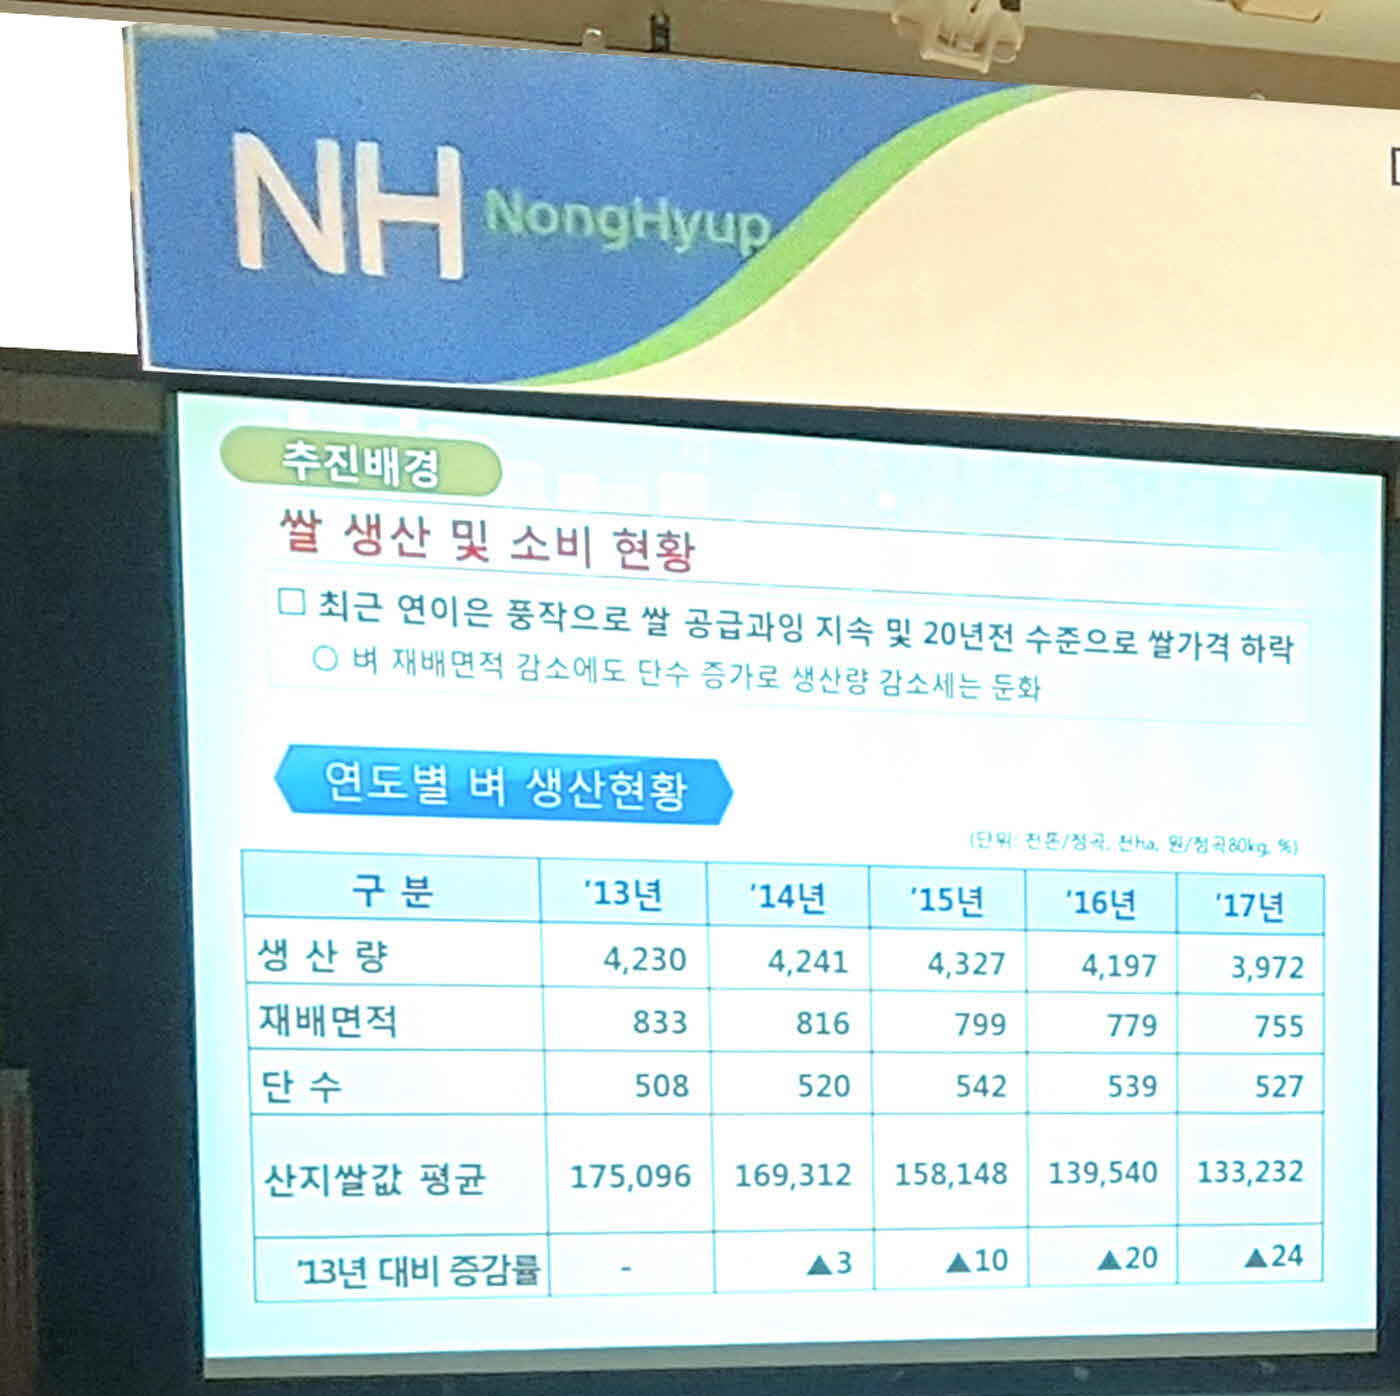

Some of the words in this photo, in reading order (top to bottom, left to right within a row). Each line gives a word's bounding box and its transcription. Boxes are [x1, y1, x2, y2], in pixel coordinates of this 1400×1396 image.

[231, 130, 464, 281] NH
[483, 187, 772, 256] NongHyup
[282, 441, 441, 488] 추진배경
[280, 509, 322, 553] 쌀
[345, 515, 430, 559] 생산
[452, 520, 489, 562] 및
[511, 526, 593, 569] 소비
[612, 529, 696, 573] 현황
[319, 590, 382, 624] 최근
[398, 594, 492, 629] 연이은
[507, 599, 631, 633] 풍작으로
[641, 606, 670, 637] 쌀
[685, 608, 803, 642] 공급과잉
[816, 616, 873, 648] 지속
[888, 619, 911, 648] 및
[924, 620, 1014, 653] 20년전
[1025, 625, 1138, 656] 수준으로
[1148, 630, 1230, 662] 쌀가격
[1241, 633, 1293, 664] 하락
[353, 646, 378, 676] 벼
[393, 647, 503, 680] 재배면적
[517, 652, 626, 684] 감소에도
[638, 659, 689, 688] 단수
[703, 661, 780, 692] 증가로
[793, 665, 869, 696] 생산량
[880, 669, 981, 700] 감소세는
[992, 673, 1041, 702] 둔화
[325, 761, 447, 806] 연도별
[469, 766, 503, 807] 벼
[526, 767, 687, 812] 생산현황
[352, 875, 386, 908] 구
[402, 875, 433, 908] 분
[584, 880, 663, 911] '13년
[750, 882, 824, 914] '14년
[911, 886, 983, 918] '15년
[1066, 889, 1136, 921] '16년
[1216, 893, 1284, 924] '17년
[257, 939, 289, 972] 생
[306, 940, 338, 973] 산
[356, 940, 388, 973] 량
[604, 947, 686, 974] 4,230
[768, 950, 849, 977] 4,241
[928, 952, 1006, 979] 4,327
[1082, 954, 1158, 981] 4,197
[1231, 956, 1304, 983] 3,972
[259, 1004, 397, 1038] 재배면적
[633, 1011, 688, 1034] 833
[796, 1012, 850, 1036] 816
[954, 1013, 1007, 1037] 799
[1107, 1014, 1158, 1038] 779
[1255, 1014, 1304, 1038] 755
[262, 1070, 293, 1103] 단
[310, 1071, 342, 1103] 수
[635, 1074, 690, 1098] 508
[798, 1074, 851, 1098] 520
[956, 1074, 1007, 1098] 542
[1108, 1074, 1158, 1098] 539
[1255, 1074, 1304, 1098] 527
[264, 1164, 403, 1197] 산지쌀값
[420, 1163, 486, 1197] 평균
[570, 1164, 692, 1194] 175,096
[736, 1163, 852, 1191] 169,312
[895, 1162, 1008, 1190] 158,148
[1049, 1161, 1158, 1189] 139,540
[1198, 1160, 1304, 1187] 133,232
[380, 1255, 440, 1287] 대비
[449, 1253, 541, 1286] 증감률
